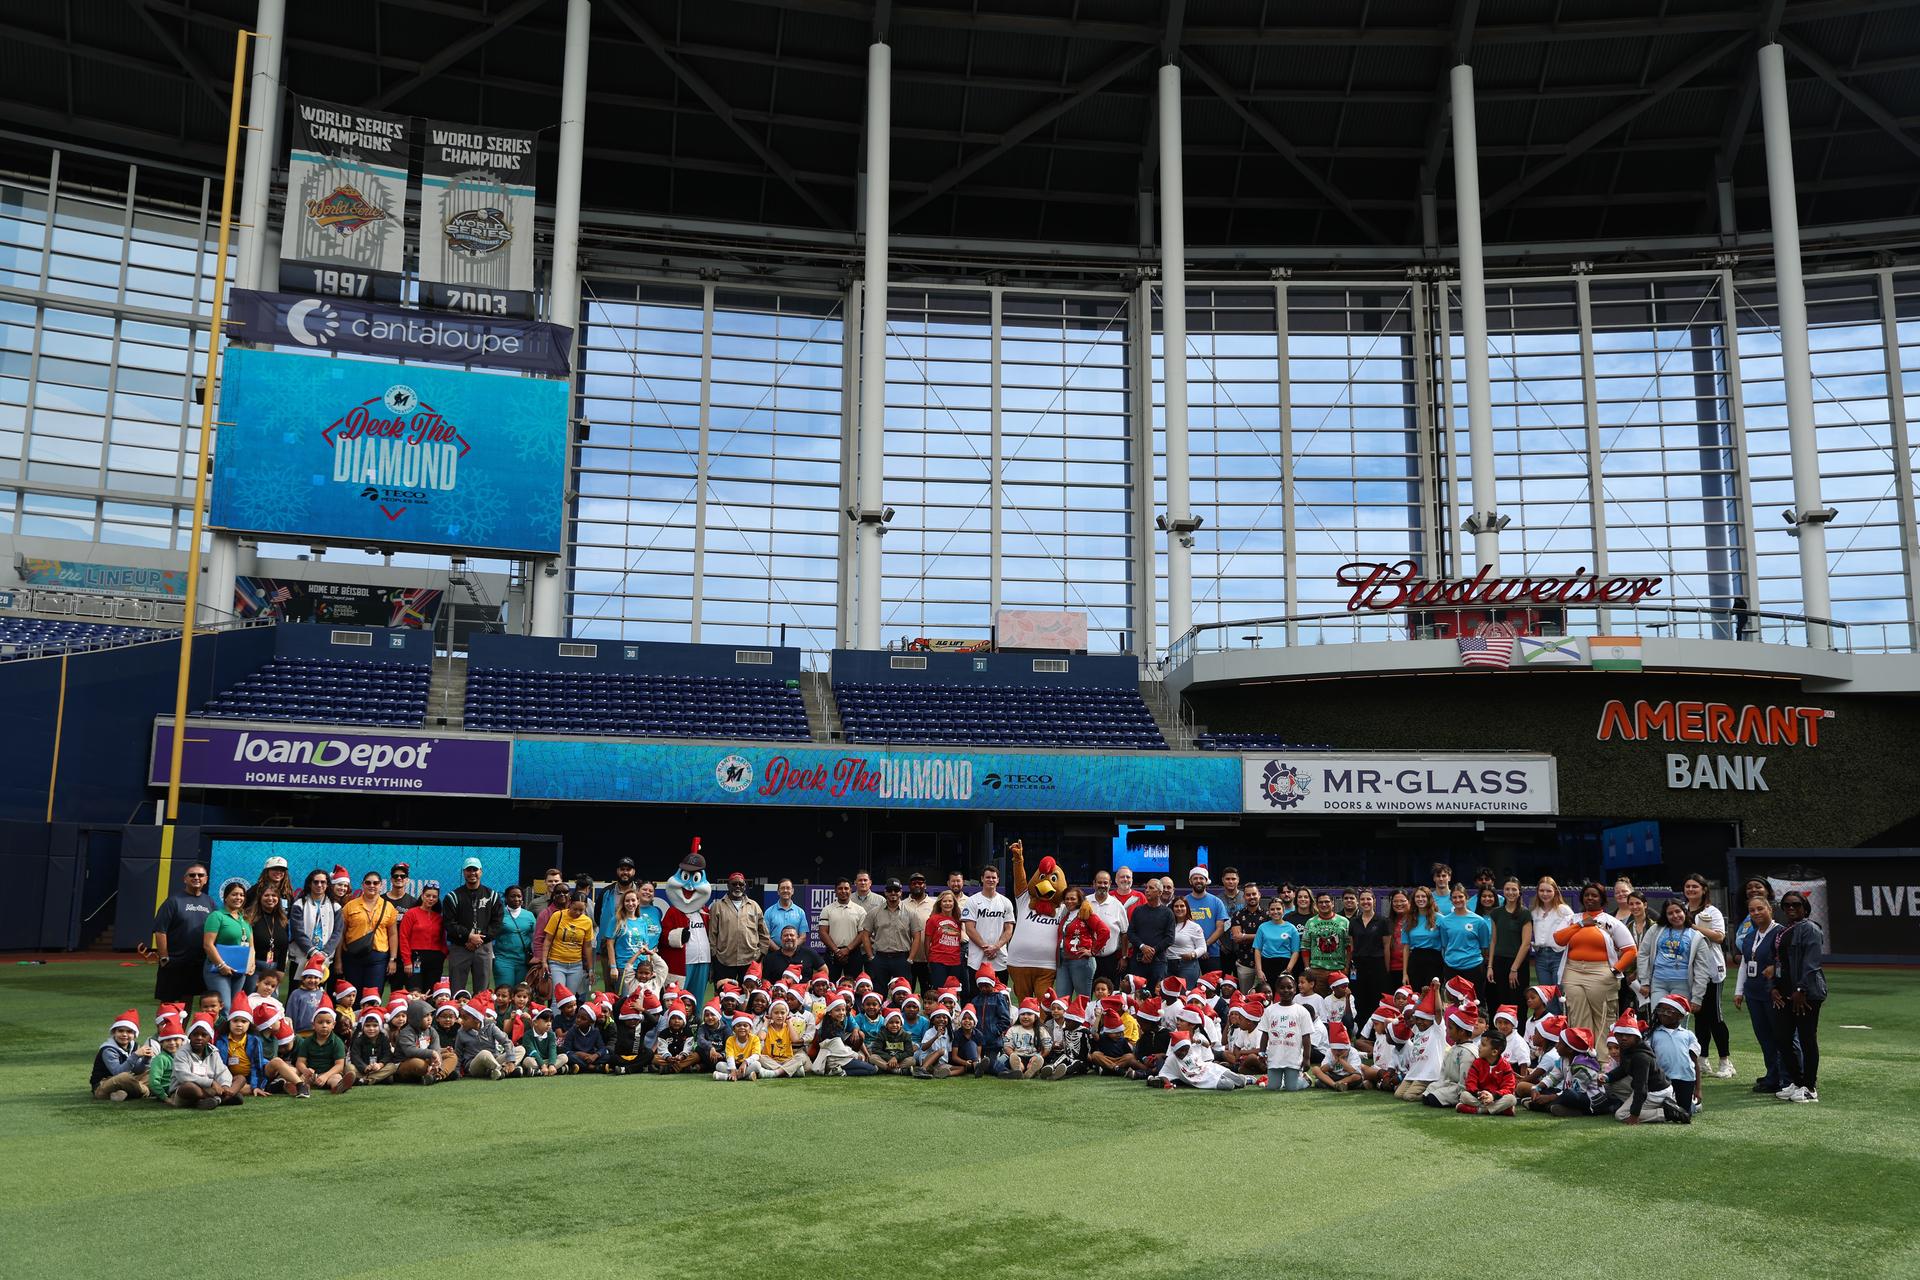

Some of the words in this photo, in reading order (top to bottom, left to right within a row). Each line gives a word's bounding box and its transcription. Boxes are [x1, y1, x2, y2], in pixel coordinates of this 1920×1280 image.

[300, 104, 351, 128] WORLD
[356, 117, 404, 139] SERIES
[310, 123, 392, 151] CHAMPIONS
[432, 130, 483, 149] WORLD
[487, 136, 532, 154] SERIES
[441, 147, 521, 169] CHAMPIONS
[446, 224, 512, 241] SERIES
[453, 219, 504, 230] WORLD
[313, 269, 368, 297] 1997
[447, 290, 507, 315] 2003
[352, 319, 519, 355] cantaloupe
[338, 406, 406, 440] Deck
[408, 412, 457, 445] The
[333, 434, 458, 491] DIAMOND
[381, 489, 426, 499] TECO
[59, 569, 81, 580] the
[84, 567, 160, 588] LINEUP
[308, 584, 328, 593] HOME
[330, 586, 339, 594] OF
[1336, 560, 1663, 611] Budweiser
[1597, 699, 1825, 747] AMERANT
[233, 732, 432, 774] loanDepot
[245, 772, 286, 783] HOME
[289, 774, 337, 785] MEANS
[340, 776, 423, 789] EVERYTHING
[758, 756, 828, 796] Deck
[830, 757, 882, 797] The
[880, 758, 972, 799] DIAMOND
[1004, 774, 1053, 783] TECO
[1323, 769, 1528, 794] MR-GLASS
[1666, 753, 1770, 791] BANK
[1324, 801, 1362, 809] DOORS
[1365, 801, 1373, 809] &
[1376, 801, 1433, 810] WINDOWS
[1435, 801, 1528, 810] MANUFACTURING
